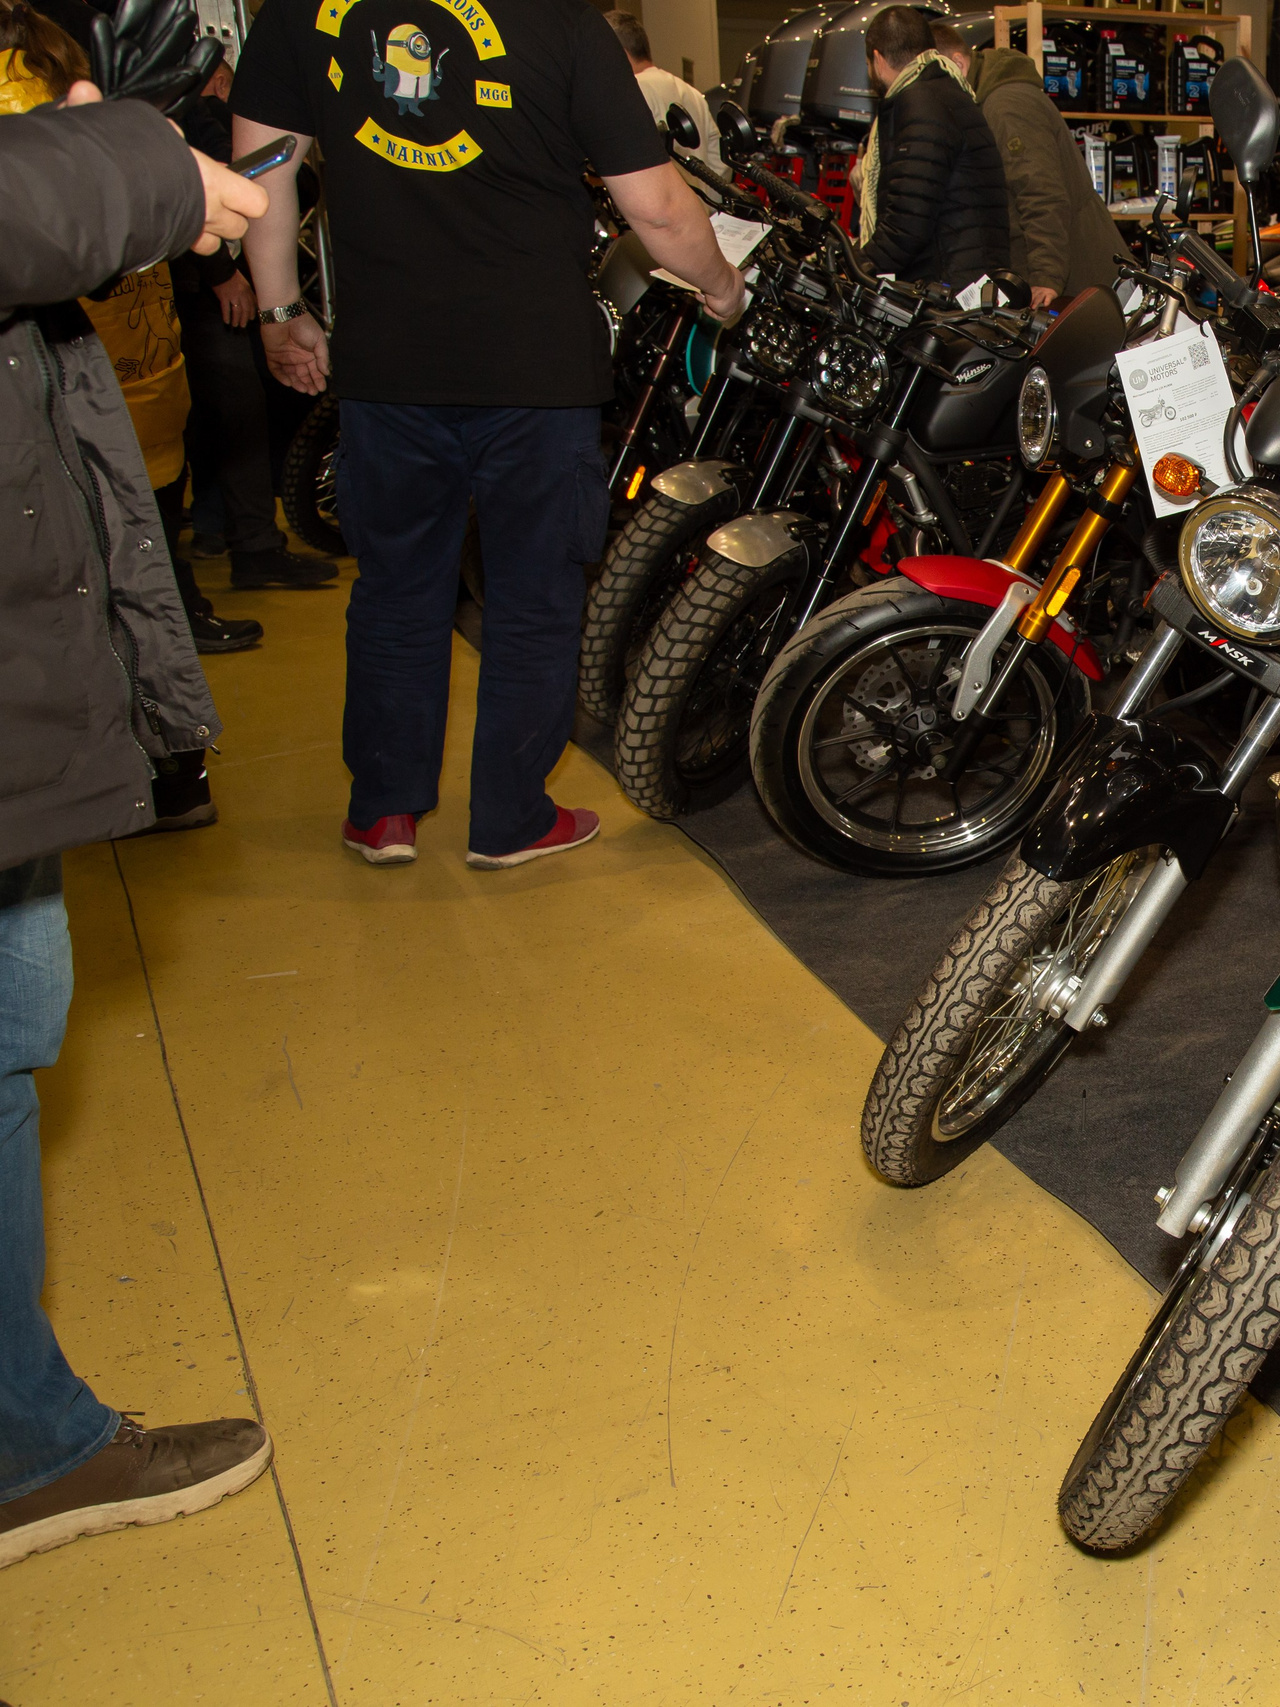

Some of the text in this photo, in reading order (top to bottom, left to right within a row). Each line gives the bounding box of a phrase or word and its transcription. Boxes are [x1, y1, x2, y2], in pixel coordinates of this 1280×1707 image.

[1048, 80, 1059, 93] 2
[1116, 82, 1128, 95] 2
[1189, 85, 1200, 98] 2
[480, 87, 509, 102] MGG
[386, 140, 457, 166] NARNIA
[1148, 359, 1185, 376] UNIVERSAL
[1132, 368, 1178, 385] UM MOTORS
